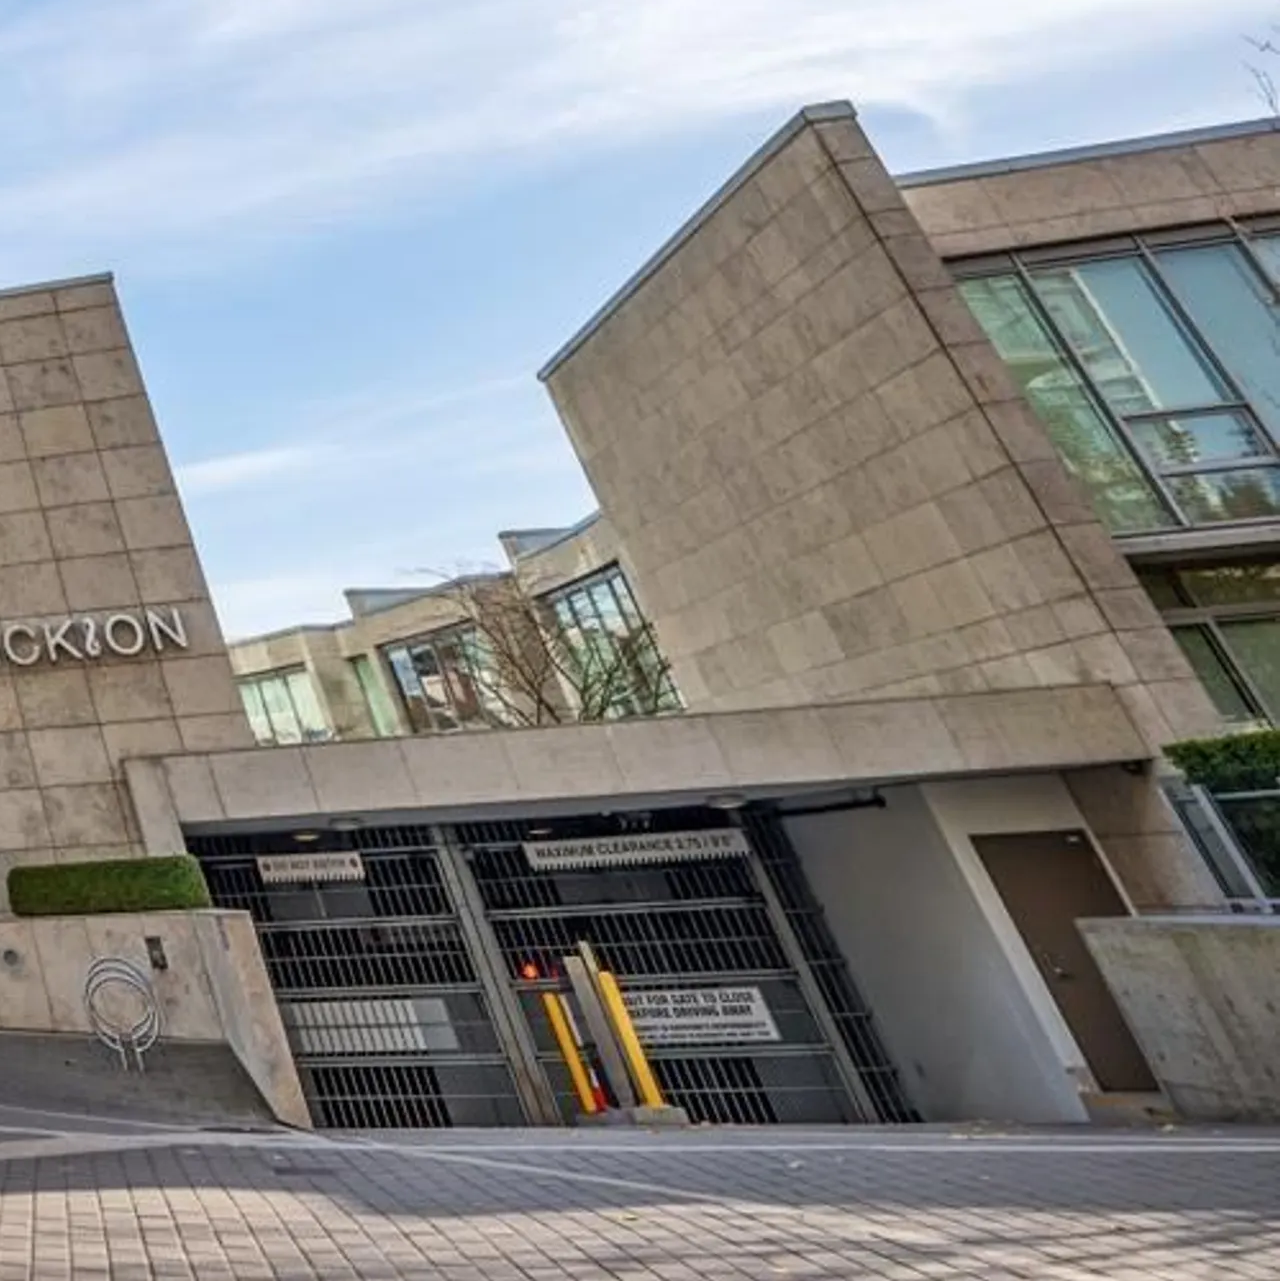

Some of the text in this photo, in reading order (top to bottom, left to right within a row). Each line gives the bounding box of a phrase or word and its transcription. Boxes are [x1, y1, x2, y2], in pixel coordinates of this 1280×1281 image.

[536, 842, 593, 858] MAXIMUM
[596, 837, 674, 854] CLEARANCE
[646, 993, 668, 1005] FOR
[670, 992, 698, 1005] GATE
[700, 992, 717, 1004] TO
[719, 990, 756, 1004] CLOSE
[673, 1006, 720, 1018] DRIVING
[721, 1004, 753, 1016] AWAY
